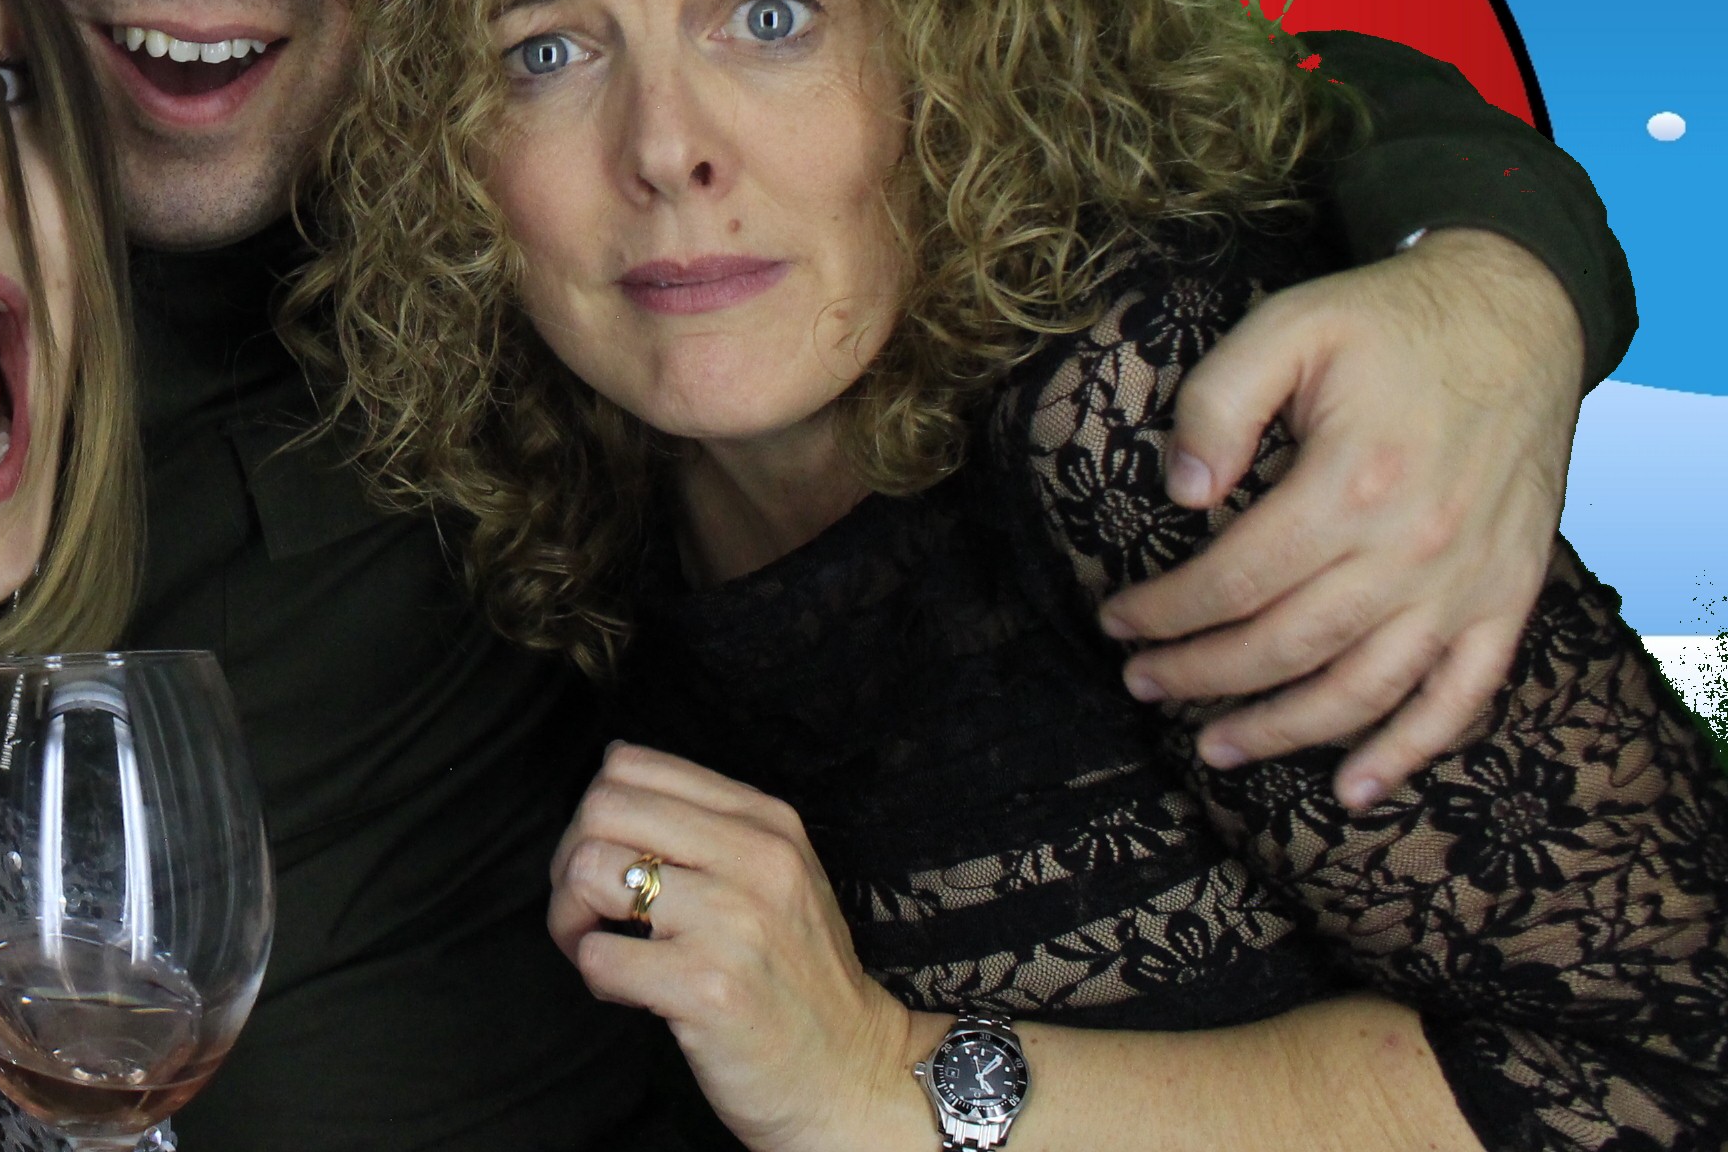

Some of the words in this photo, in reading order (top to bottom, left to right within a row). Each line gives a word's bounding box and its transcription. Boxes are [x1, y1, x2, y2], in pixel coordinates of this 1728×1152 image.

[941, 1043, 953, 1054] 20
[1014, 1057, 1024, 1068] 40
[1009, 1094, 1021, 1107] 50
